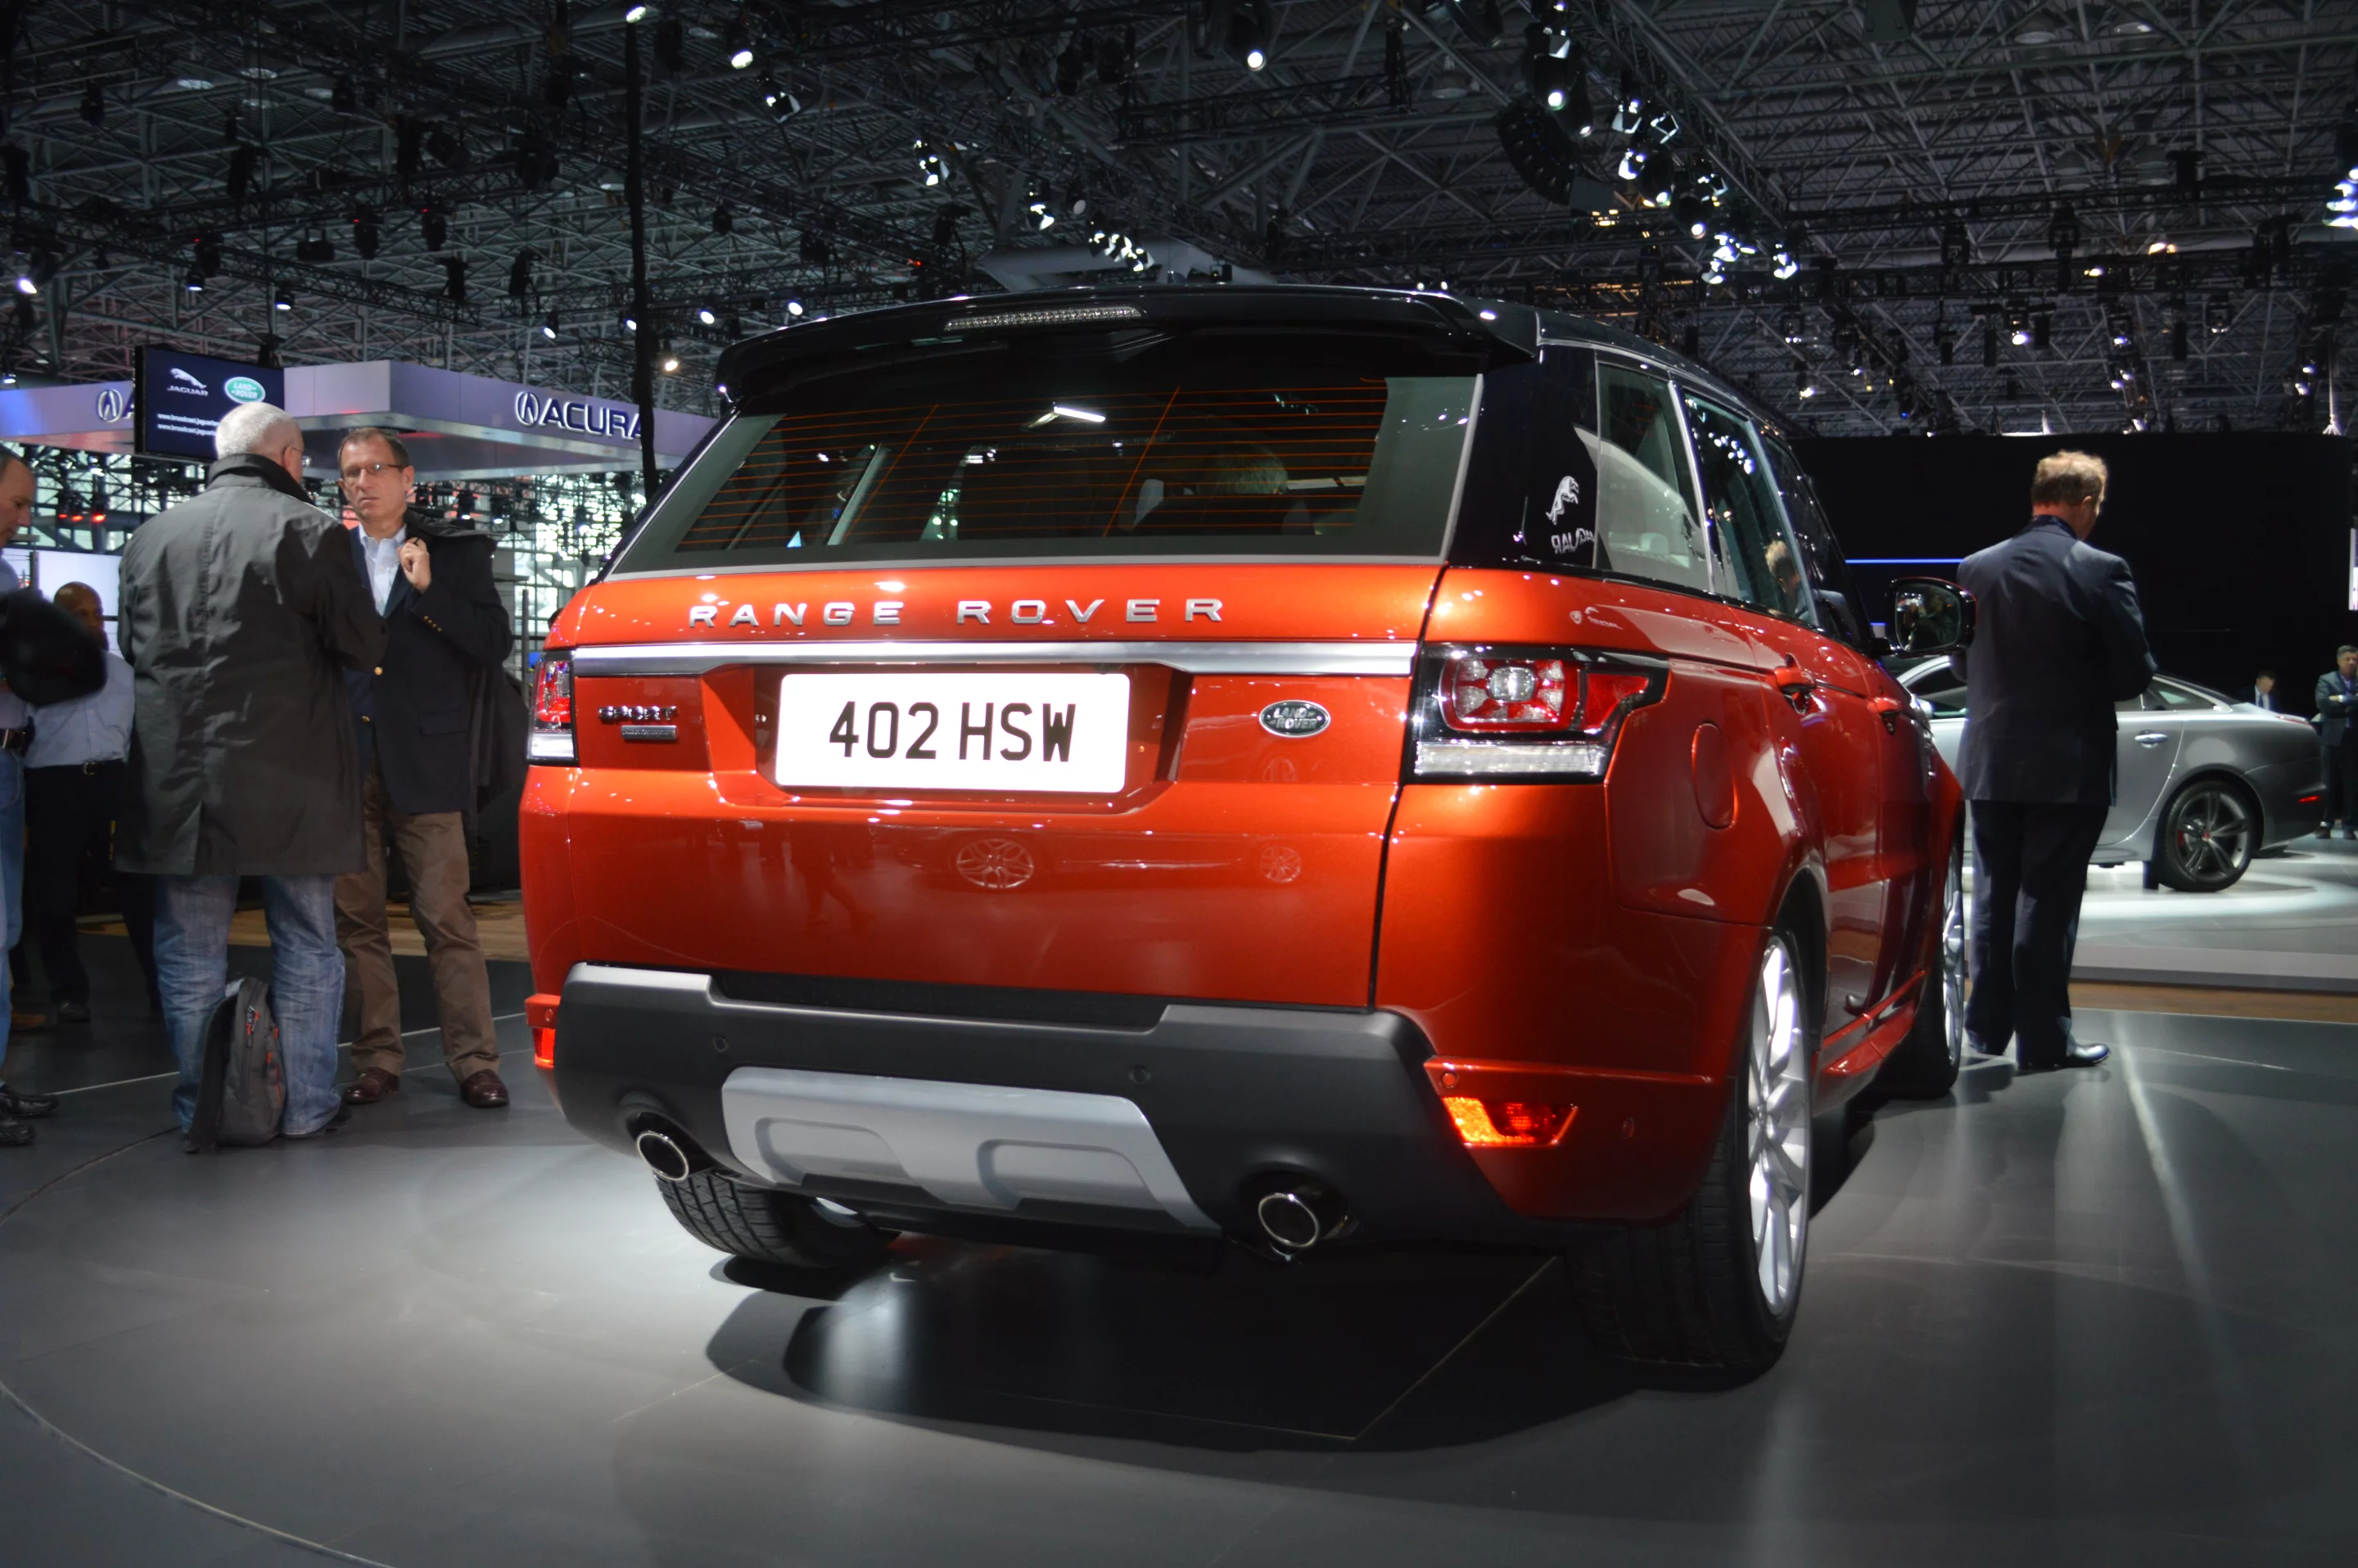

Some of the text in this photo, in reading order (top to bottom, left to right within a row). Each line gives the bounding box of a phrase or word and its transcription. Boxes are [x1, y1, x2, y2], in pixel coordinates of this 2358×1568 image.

[167, 385, 209, 396] JAGUAR
[233, 382, 252, 391] LAND
[235, 390, 259, 400] ROVER
[689, 599, 1222, 627] RANGE ROVER
[1273, 707, 1308, 718] LAND
[1275, 717, 1318, 729] ROVER
[828, 700, 1077, 762] 402 HSW
